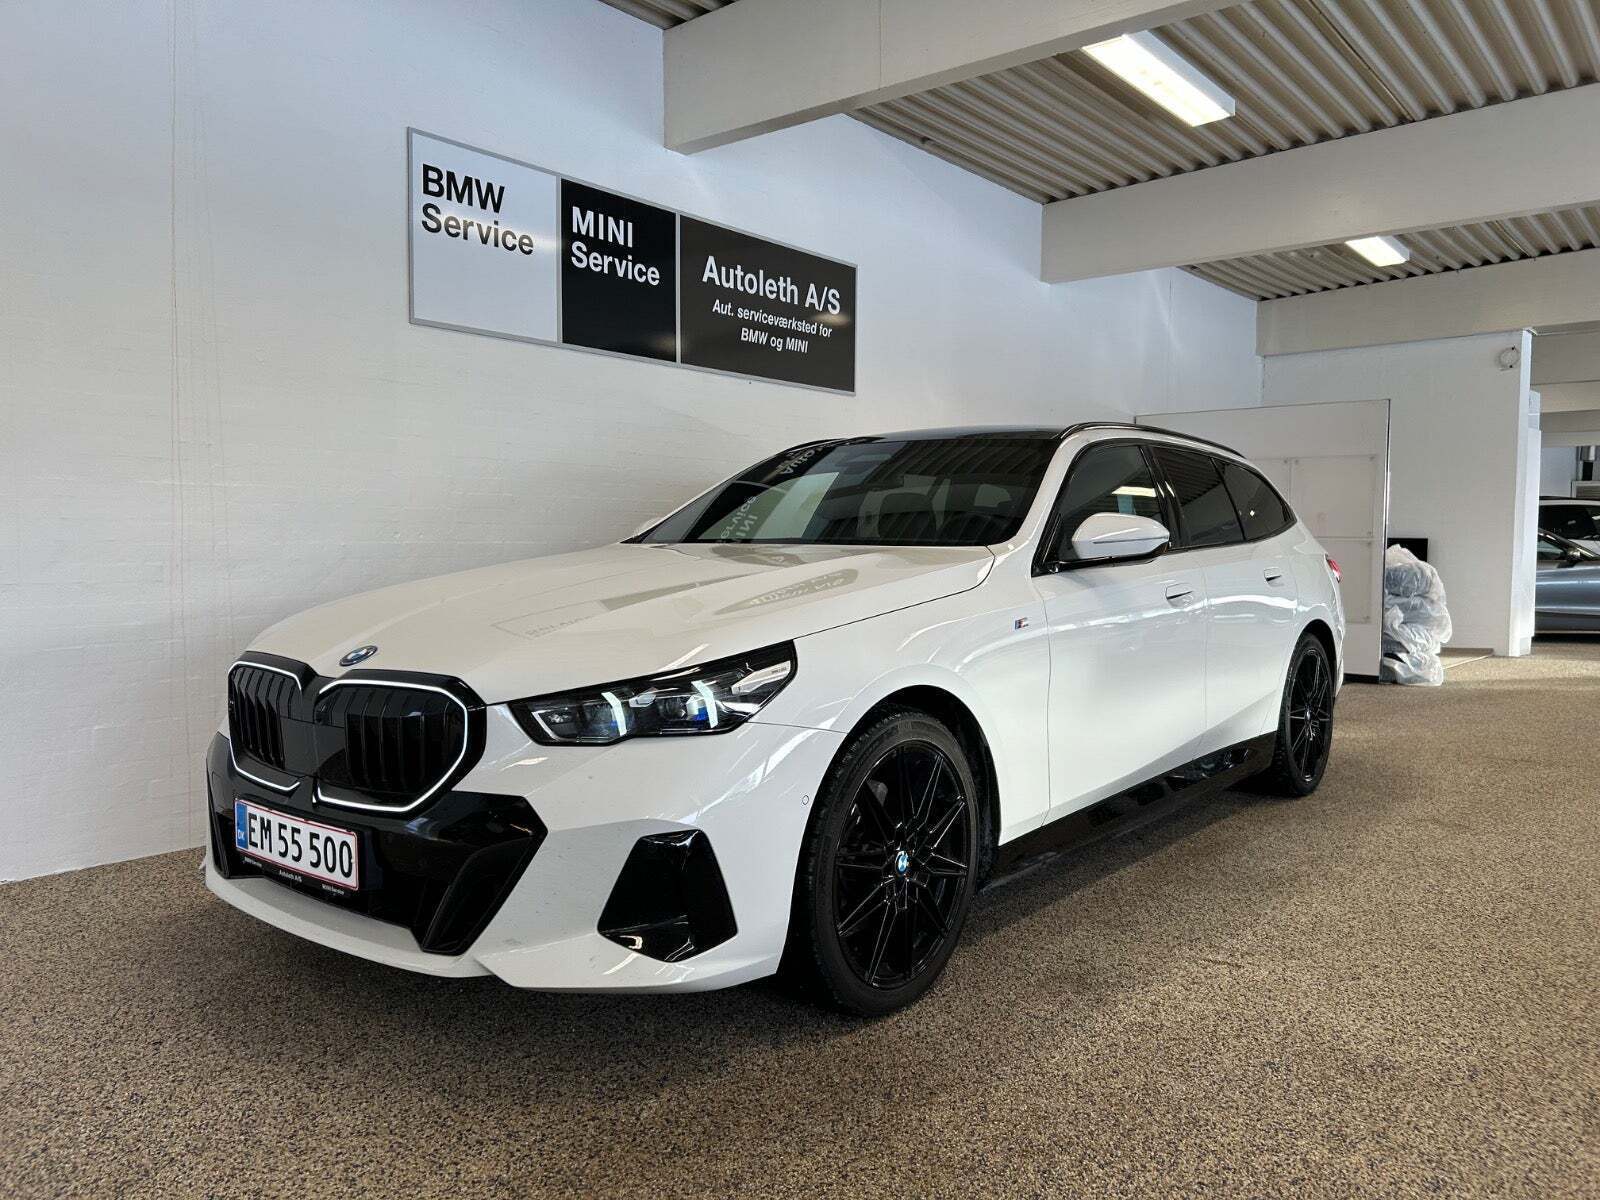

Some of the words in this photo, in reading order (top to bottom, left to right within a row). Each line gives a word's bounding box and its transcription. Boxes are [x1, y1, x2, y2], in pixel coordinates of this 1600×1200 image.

[422, 163, 506, 214] BMW
[421, 202, 535, 256] Service
[572, 205, 633, 248] MINI
[571, 240, 661, 286] Service
[702, 255, 799, 305] Autoleth
[804, 283, 842, 316] A/S
[712, 299, 735, 317] Aut.
[737, 306, 818, 335] serviceværksted
[818, 323, 834, 338] for
[740, 327, 769, 345] BMW
[770, 336, 784, 352] og
[785, 337, 810, 354] MINI
[248, 812, 273, 853] EM
[278, 822, 302, 863] 55
[309, 831, 353, 878] 500
